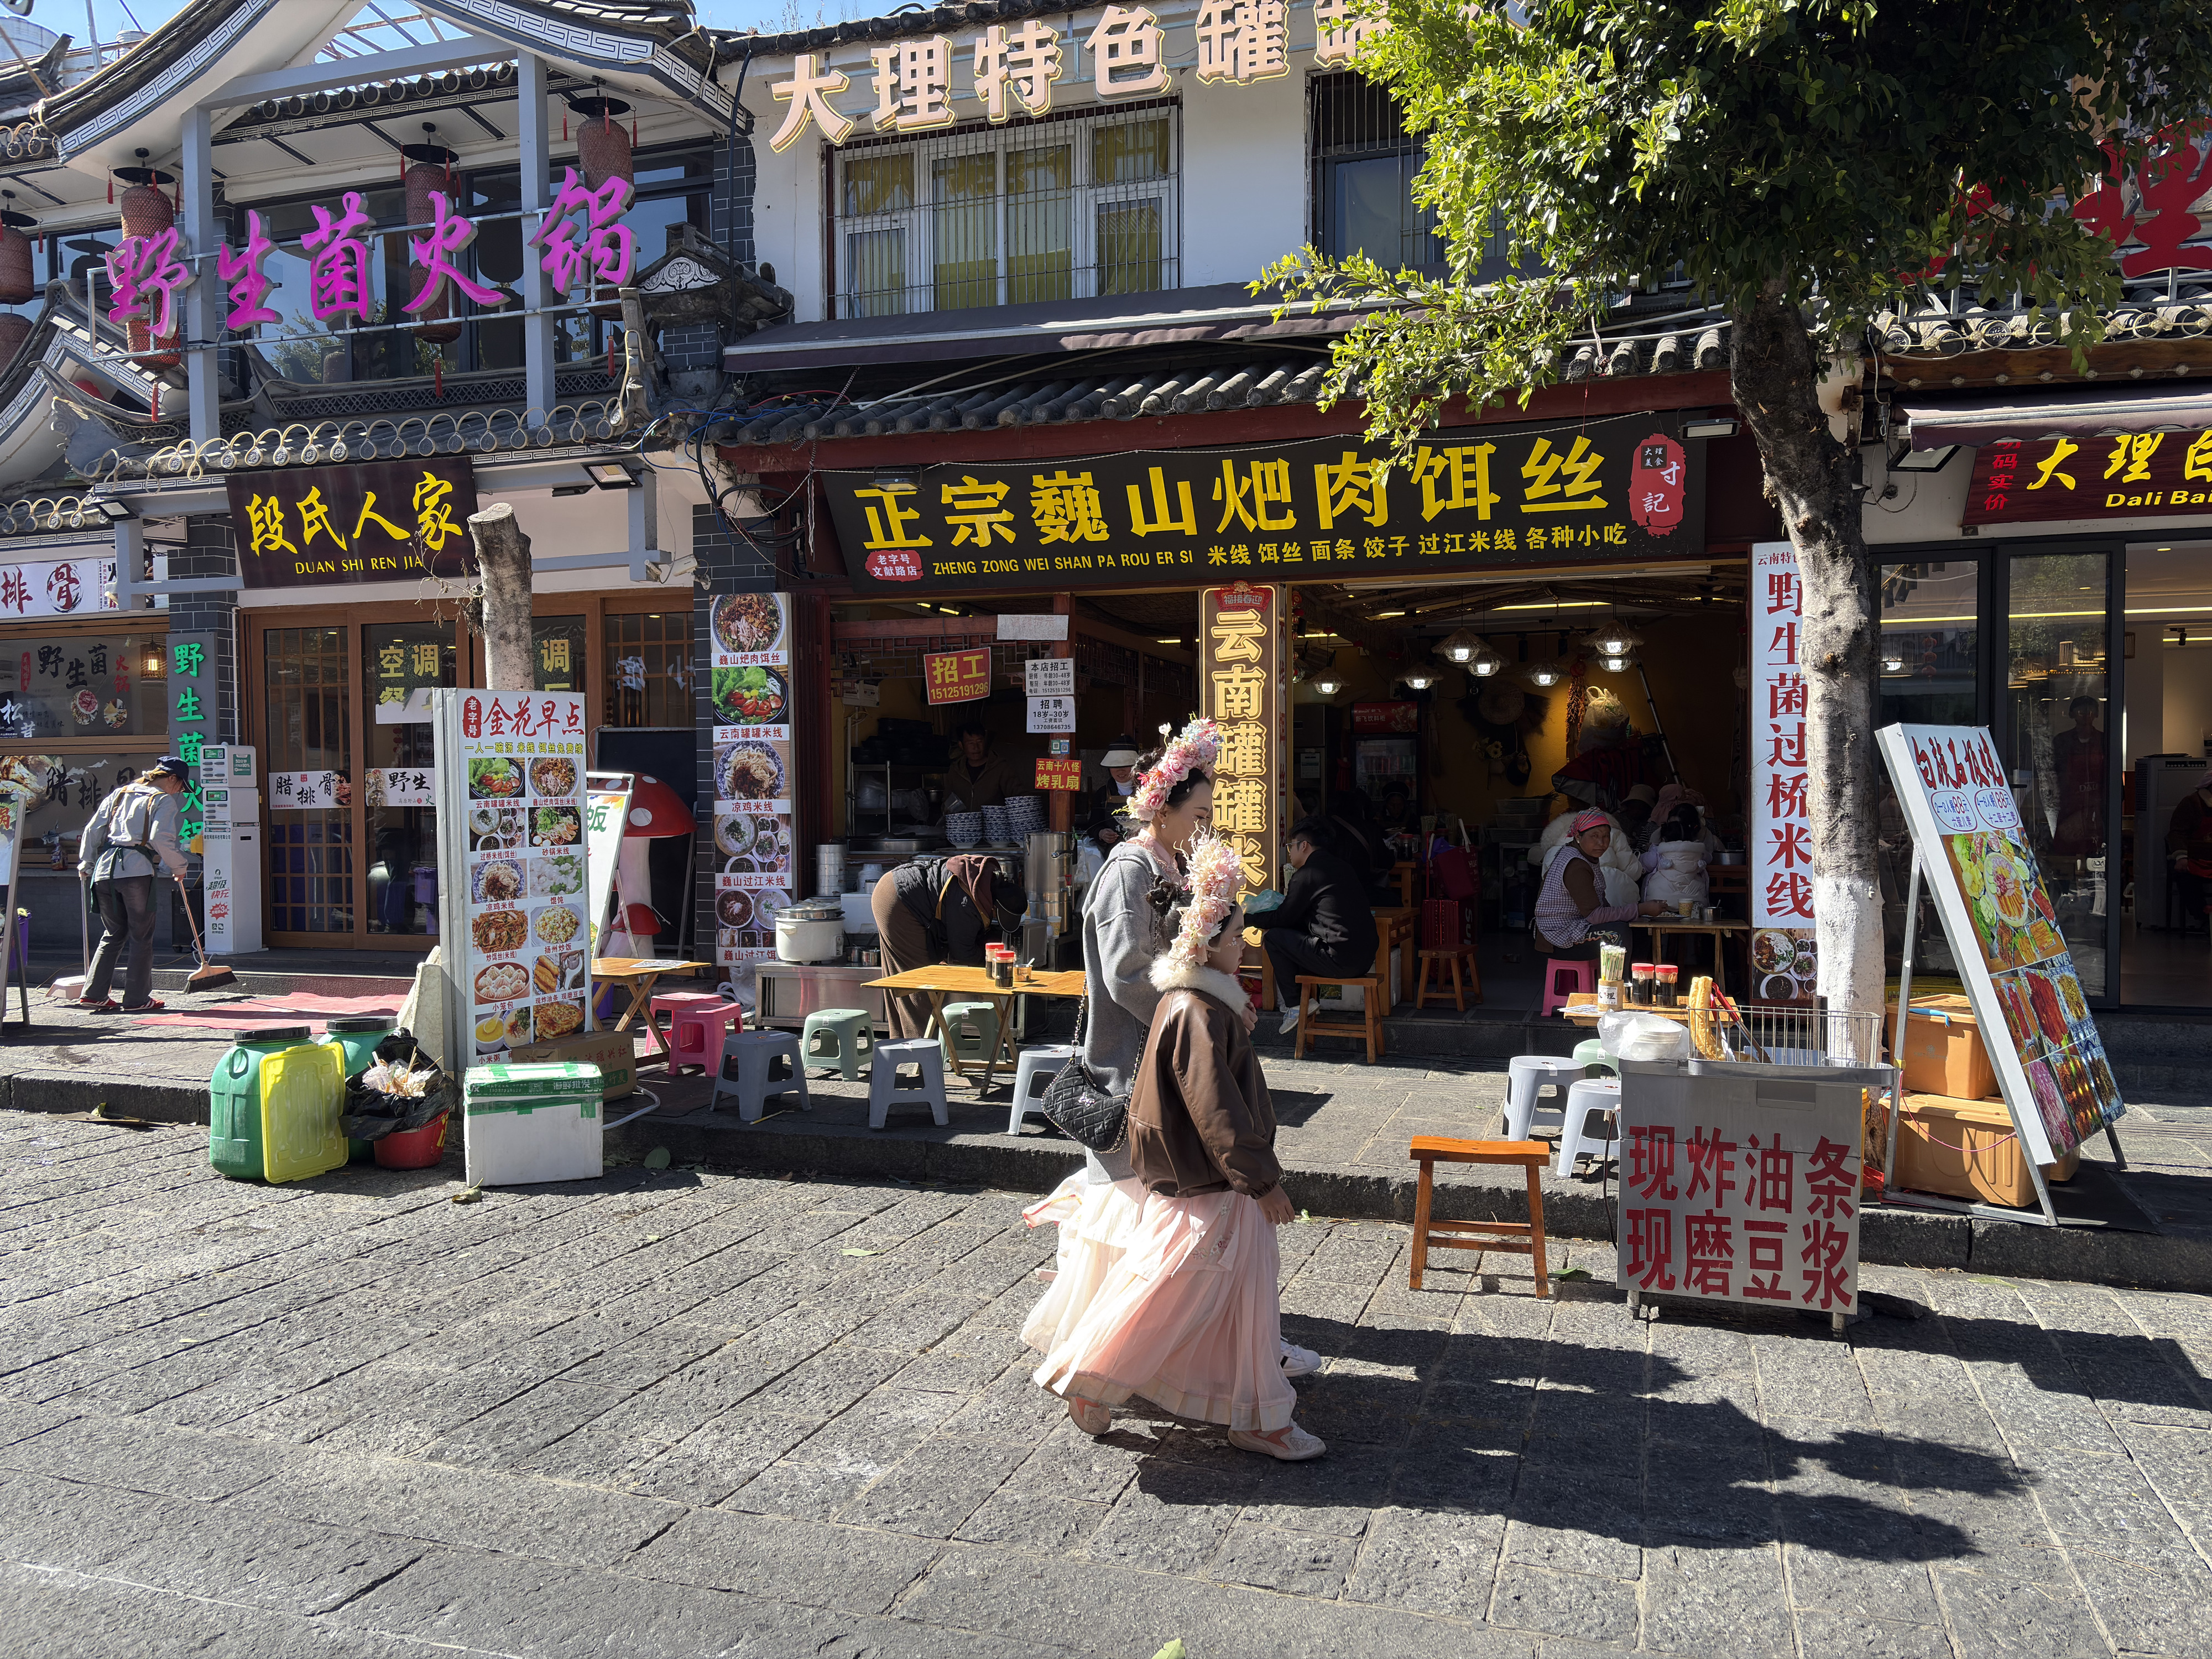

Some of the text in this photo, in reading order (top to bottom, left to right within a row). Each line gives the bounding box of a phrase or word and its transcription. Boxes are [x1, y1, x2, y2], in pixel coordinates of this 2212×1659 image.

[106, 166, 636, 338] 野生菌火锅
[1645, 447, 1663, 456] 大理
[1645, 457, 1664, 467] 美食
[2105, 492, 2163, 508] Dali
[246, 471, 462, 557] 段氏人家
[1207, 523, 1627, 566] 米线 饵丝 面条 饺子 过江米线 各种小吃
[296, 555, 423, 574] DUAN SHI REN JIA
[877, 554, 910, 565] 老字号
[933, 550, 1193, 575] ZHENG ZONG WEI SHAN PA ROU ER SI
[873, 565, 917, 577] 文献路店
[1, 564, 81, 614] 排骨
[379, 645, 439, 677] 空调
[541, 639, 570, 672] 调
[38, 644, 107, 689] 野生菌
[932, 655, 986, 685] 招工
[1031, 662, 1068, 671] 本店招工
[931, 682, 988, 700] 15125191296
[1040, 699, 1063, 709] 招聘
[468, 699, 478, 737] 老字号
[483, 695, 585, 740] 金花早点
[719, 727, 783, 739] 云南罐罐米线
[465, 742, 583, 755] 一人一碗汤 米线 饵丝免费续
[1766, 572, 1814, 918] 野生菌过桥米线
[1037, 760, 1079, 773] 云南十八怪
[389, 771, 431, 792] 野生
[1036, 774, 1079, 790] 烤乳扇
[276, 773, 336, 806] 腊排骨
[476, 800, 520, 808] 云南罐罐米线
[732, 801, 774, 813] 凉鸡米线
[542, 847, 570, 856] 砂锅米线
[206, 880, 227, 890] 超级
[722, 875, 786, 887] 巍山过江米线
[211, 889, 230, 899] 快充
[550, 896, 564, 905] 馄饨
[486, 901, 515, 911] 凉鸡米线
[544, 943, 572, 954] 扬州炒饭
[724, 950, 780, 961] 巍山过江饵
[535, 989, 585, 1005] 现炸油条 现磨豆浆
[492, 1001, 514, 1011] 小笼包
[478, 1054, 500, 1065] 小米粥
[553, 1079, 590, 1090] 海鲜批发
[1628, 1126, 1857, 1219] 现炸油条
[1626, 1208, 1853, 1310] 现磨豆浆
